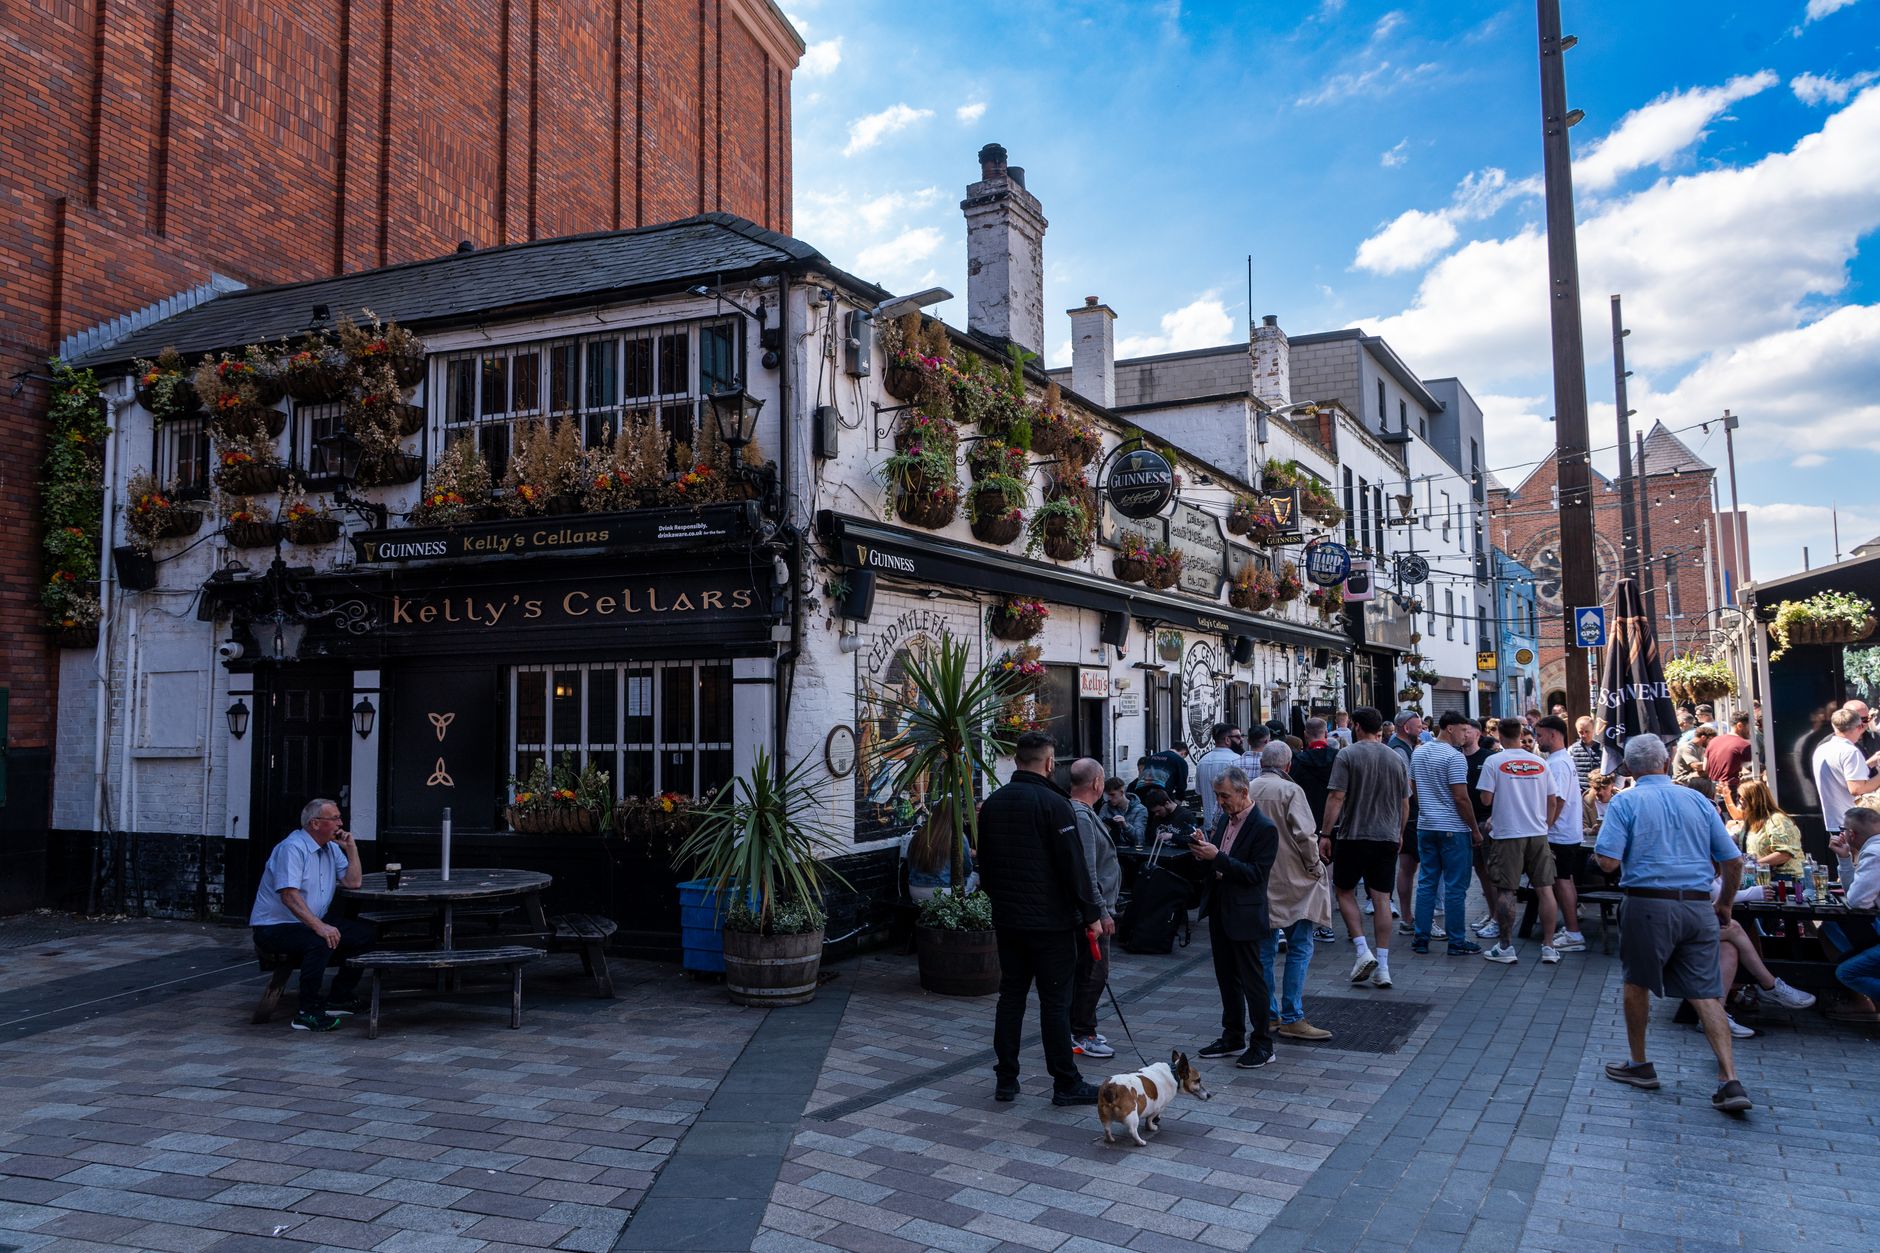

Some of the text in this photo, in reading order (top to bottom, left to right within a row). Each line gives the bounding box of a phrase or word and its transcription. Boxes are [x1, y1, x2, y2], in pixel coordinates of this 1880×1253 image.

[1111, 471, 1167, 488] GUINNESS
[379, 529, 609, 558] GUINNESS Kelly's Cellars
[1266, 535, 1301, 545] GUINNESS
[869, 549, 915, 572] GUINNESS
[393, 595, 543, 627] Kelly's
[867, 624, 898, 674] CÉAD
[1081, 671, 1108, 696] Kelly's
